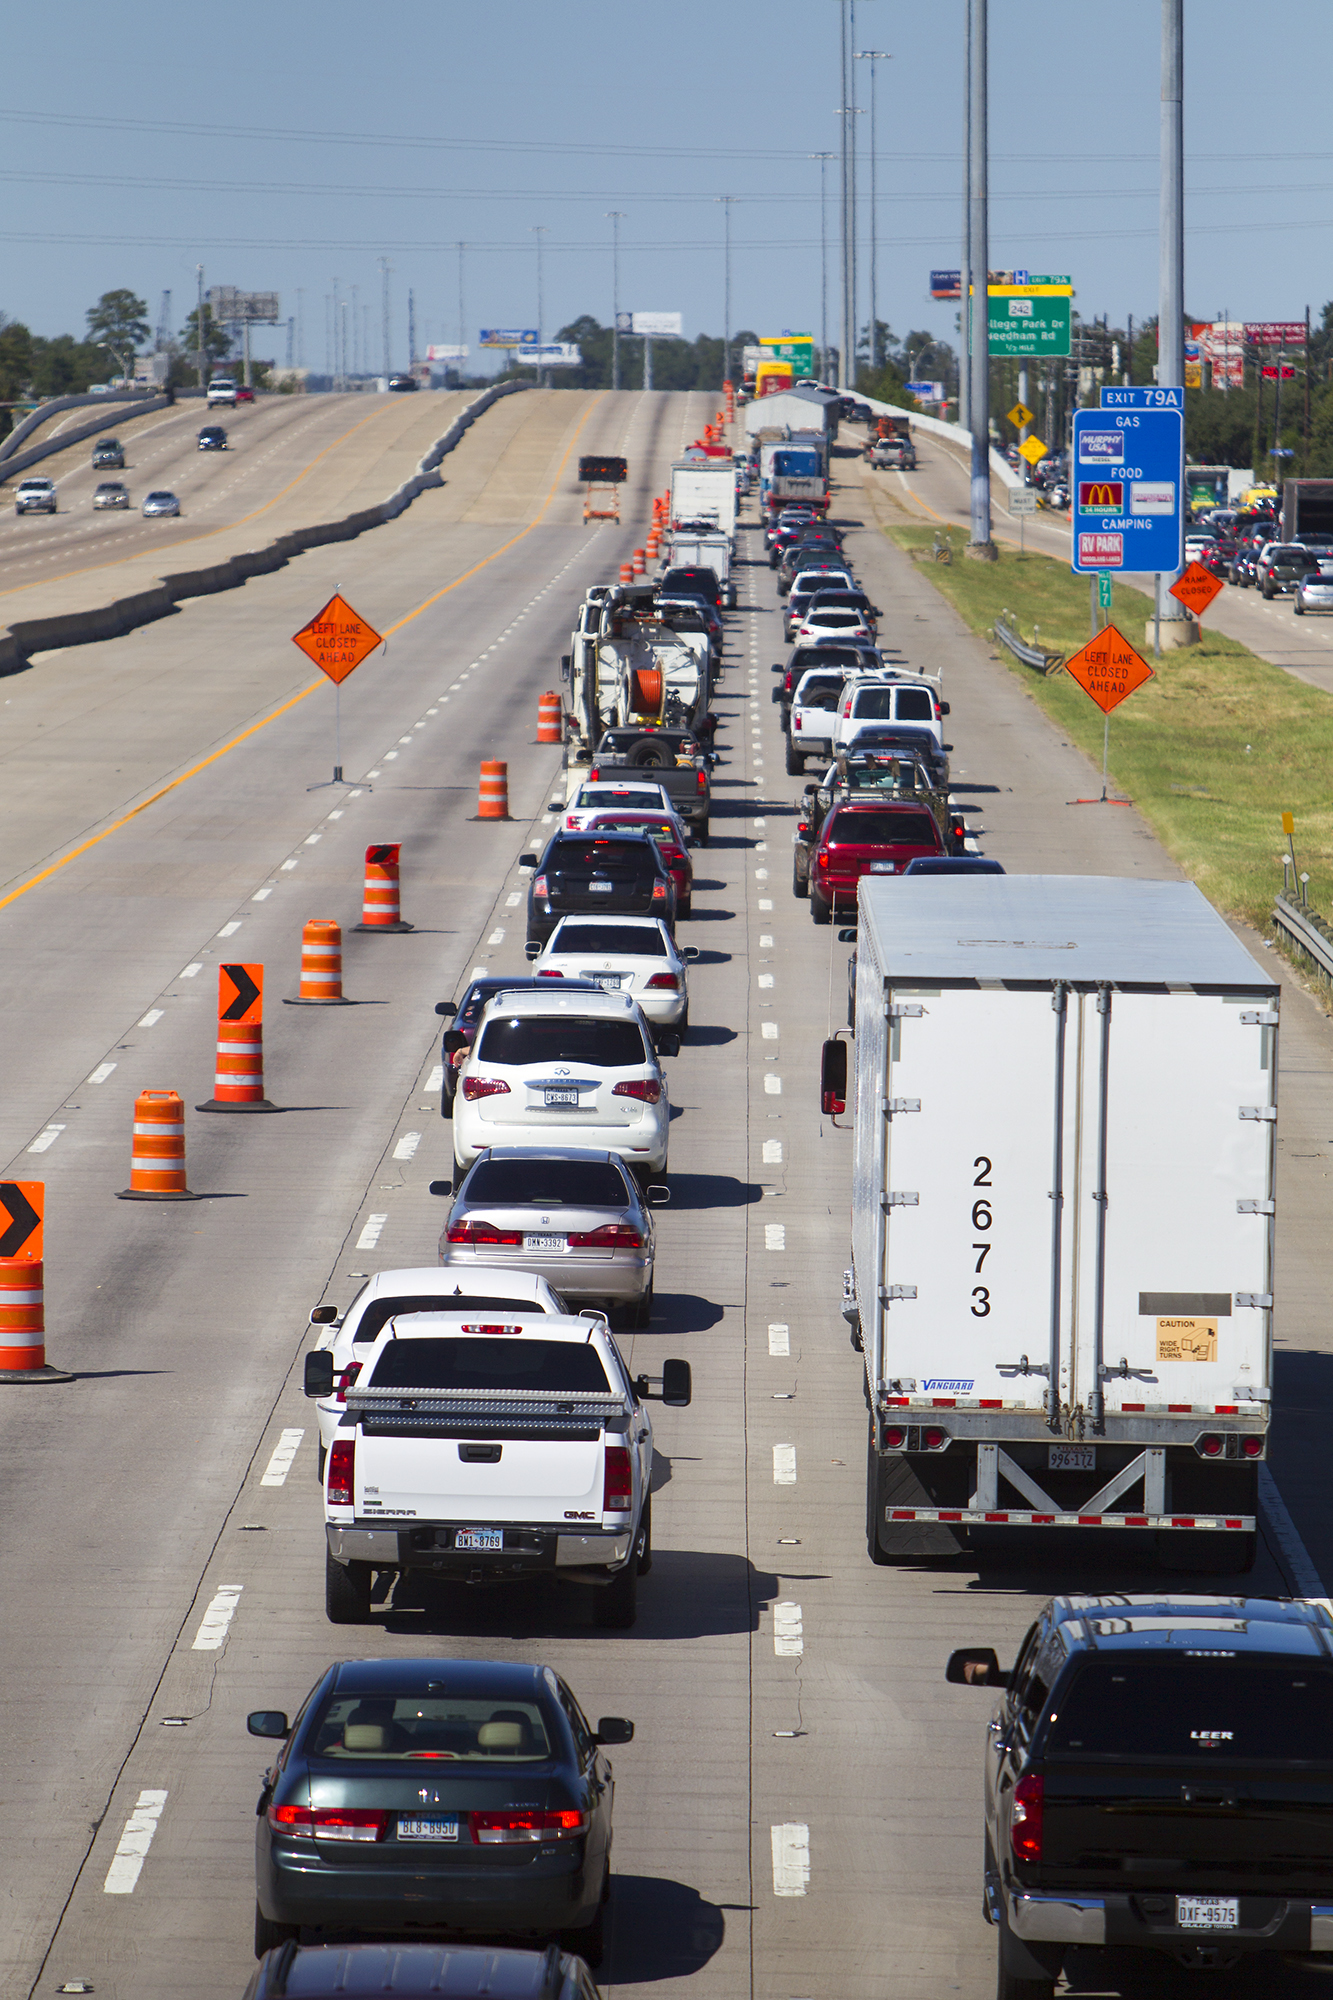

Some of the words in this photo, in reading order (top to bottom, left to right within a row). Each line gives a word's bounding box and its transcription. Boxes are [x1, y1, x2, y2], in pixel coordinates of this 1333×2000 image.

[1049, 275, 1067, 284] 79A
[1010, 304, 1029, 315] 242
[988, 319, 1018, 330] llege
[1022, 320, 1046, 329] Park
[1051, 320, 1064, 329] Dr
[1041, 331, 1055, 340] Rd
[1106, 392, 1136, 404] EXIT
[1143, 390, 1179, 406] 79A
[1115, 416, 1140, 427] GAS
[1081, 435, 1122, 444] MURPHY
[1088, 443, 1107, 451] USA
[1111, 467, 1143, 479] FOOD
[1101, 519, 1153, 530] CAMPING
[1082, 536, 1096, 553] RV
[1096, 536, 1120, 552] PARK
[1184, 576, 1208, 584] RAMP
[1181, 586, 1212, 595] CLOSED
[311, 622, 335, 634] LEFT
[340, 623, 361, 634] LANE
[316, 637, 357, 649] CLOSED
[319, 651, 355, 663] AHEAD
[1084, 651, 1107, 663] LEFT
[1112, 653, 1133, 665] LANE
[1087, 666, 1129, 679] CLOSED
[1089, 681, 1126, 693] AHEAD
[1160, 1320, 1195, 1328] CAUTION
[363, 1508, 417, 1516] SIERRA
[564, 1510, 596, 1520] GMC
[1190, 1730, 1234, 1740] LEER
